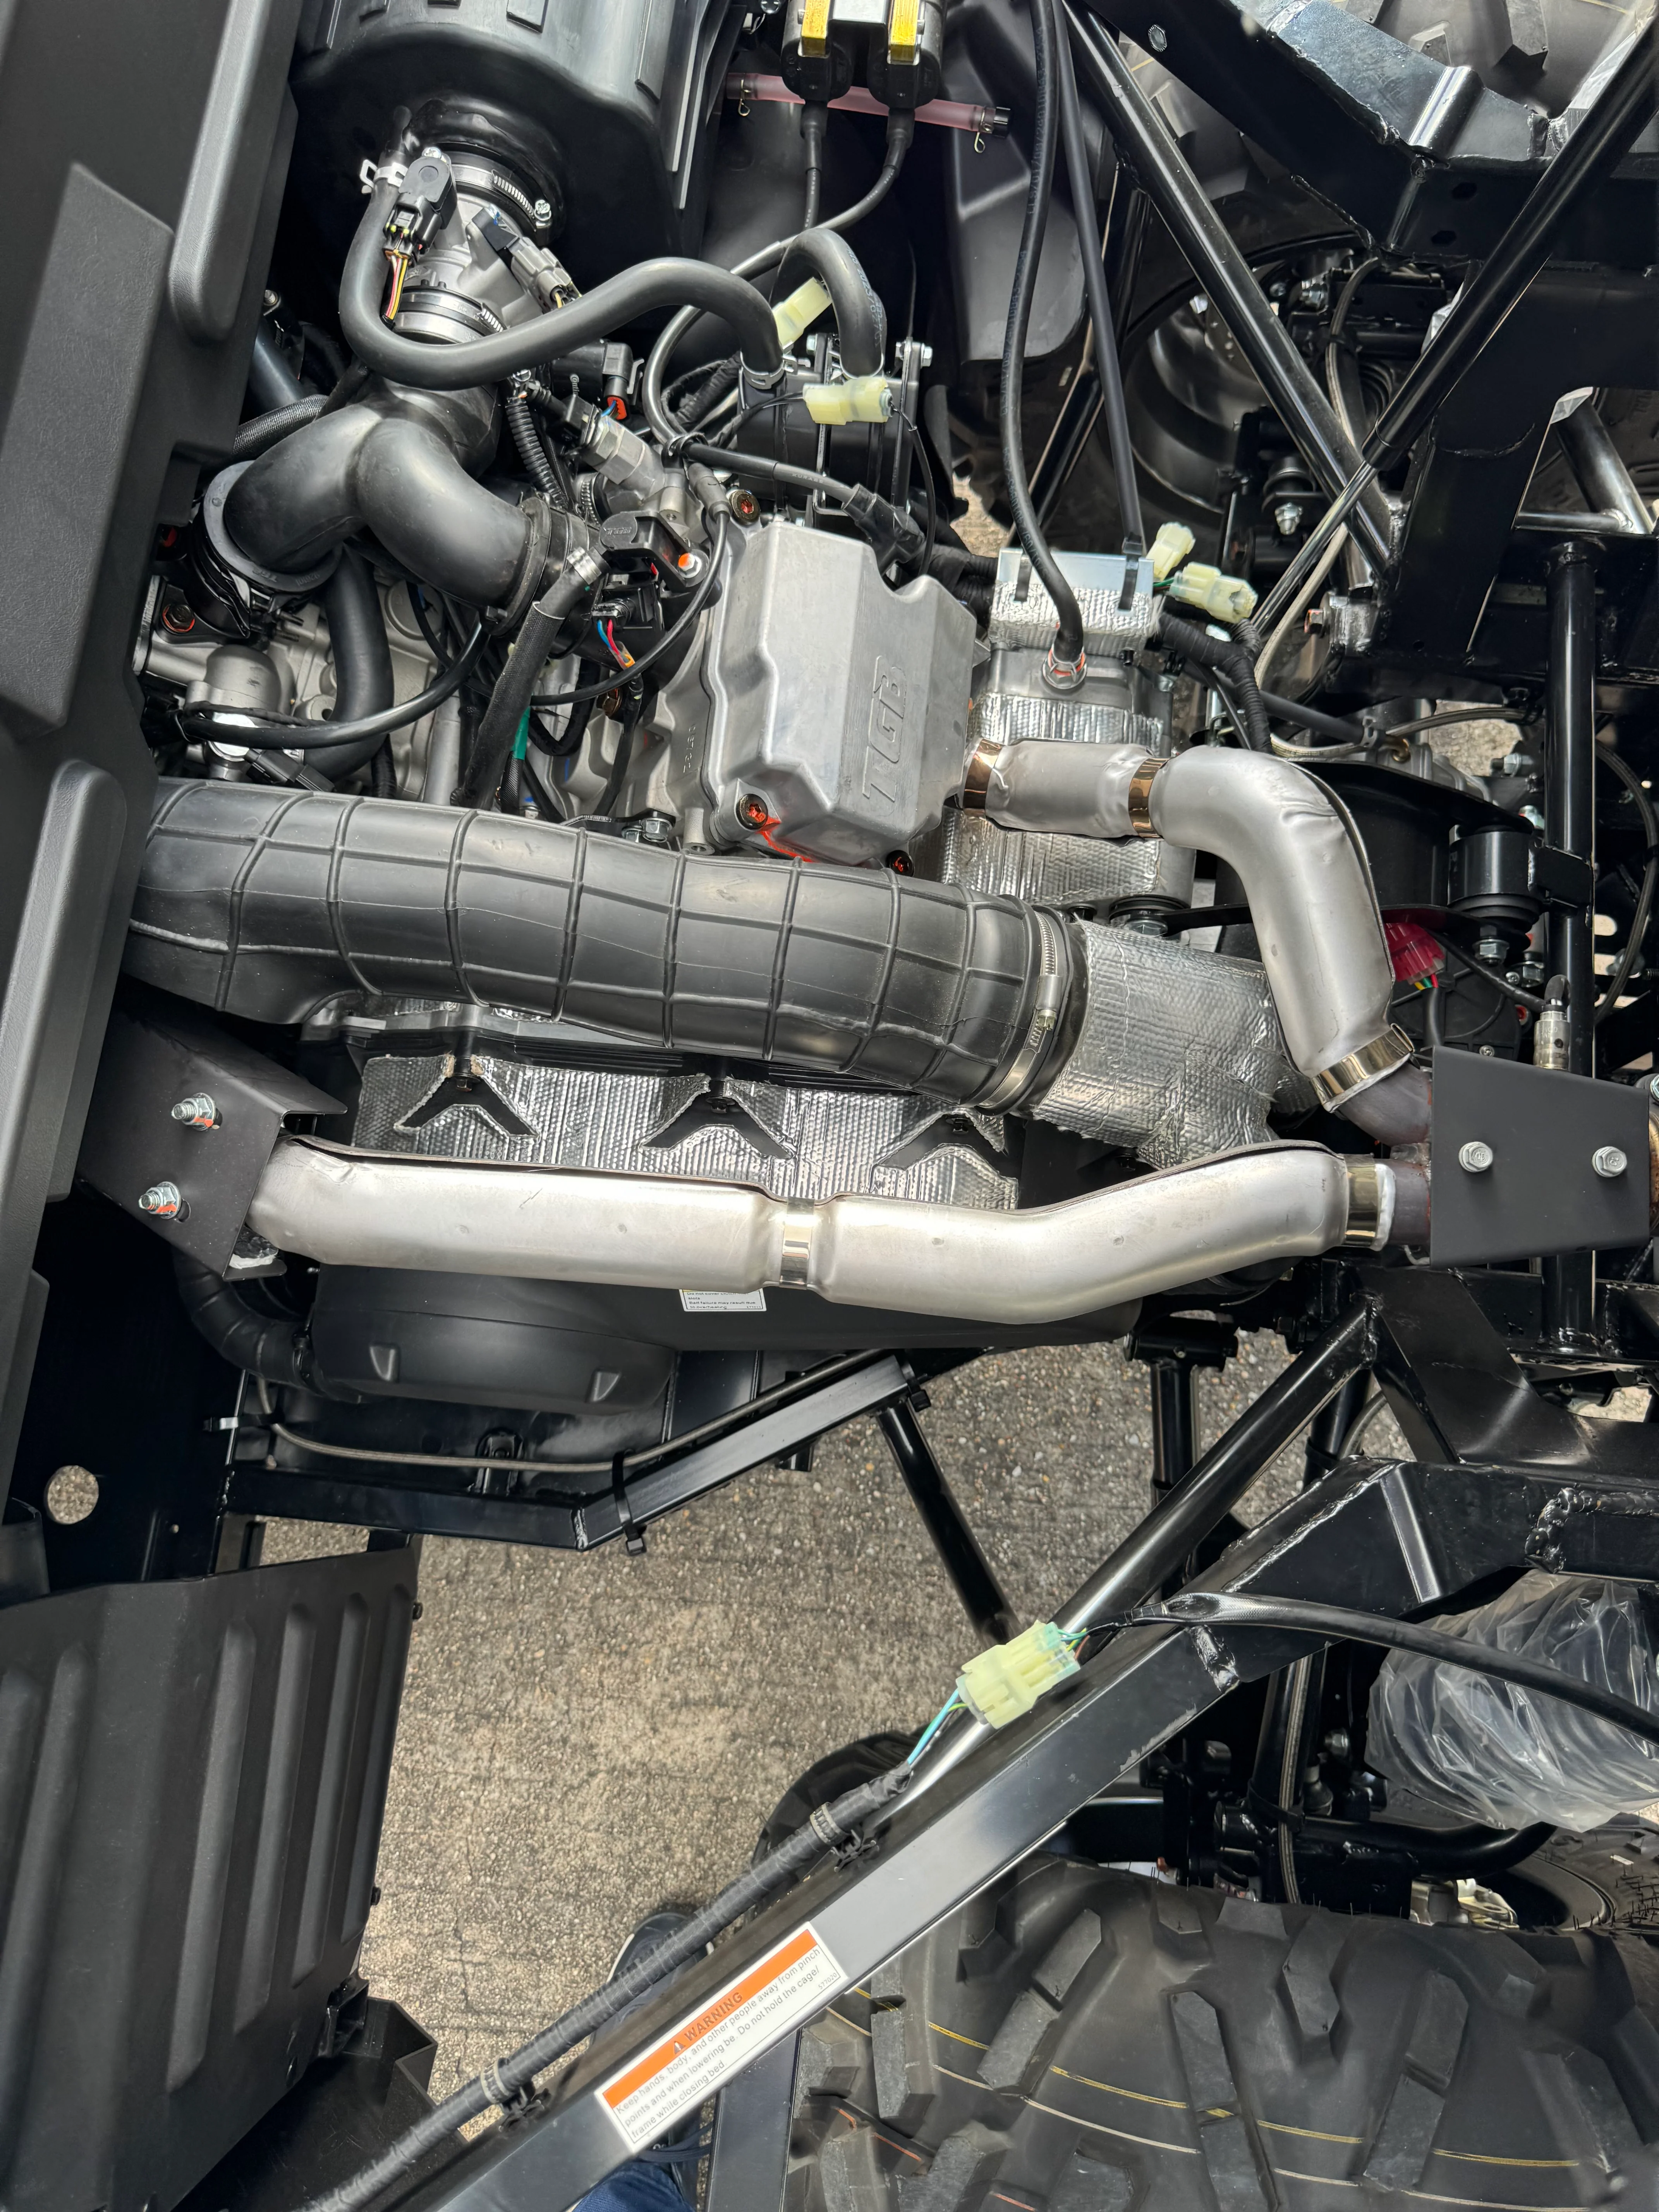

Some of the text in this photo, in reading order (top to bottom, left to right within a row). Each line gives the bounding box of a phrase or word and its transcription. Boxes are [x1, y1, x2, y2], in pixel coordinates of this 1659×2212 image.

[862, 655, 907, 803] TGB
[616, 2095, 639, 2114] Keep
[666, 2055, 691, 2074] body,
[691, 2038, 707, 2055] and
[707, 2022, 728, 2042] other
[728, 2000, 756, 2026] people
[757, 1982, 778, 2002] away
[778, 1967, 798, 1984] from
[798, 1949, 820, 1970] pinch
[684, 1992, 742, 2040] WARNING
[818, 1972, 837, 1989] 577020
[625, 2104, 650, 2128] points
[651, 2089, 666, 2105] and
[666, 2072, 689, 2092] when
[688, 2044, 725, 2074] lowering
[737, 2023, 750, 2035] Do
[750, 2010, 765, 2025] not
[763, 1995, 783, 2013] hold
[782, 1985, 797, 1998] the
[797, 1965, 819, 1987] cage/
[631, 2116, 656, 2138] frame
[656, 2099, 678, 2118] while
[679, 2075, 709, 2100] closing
